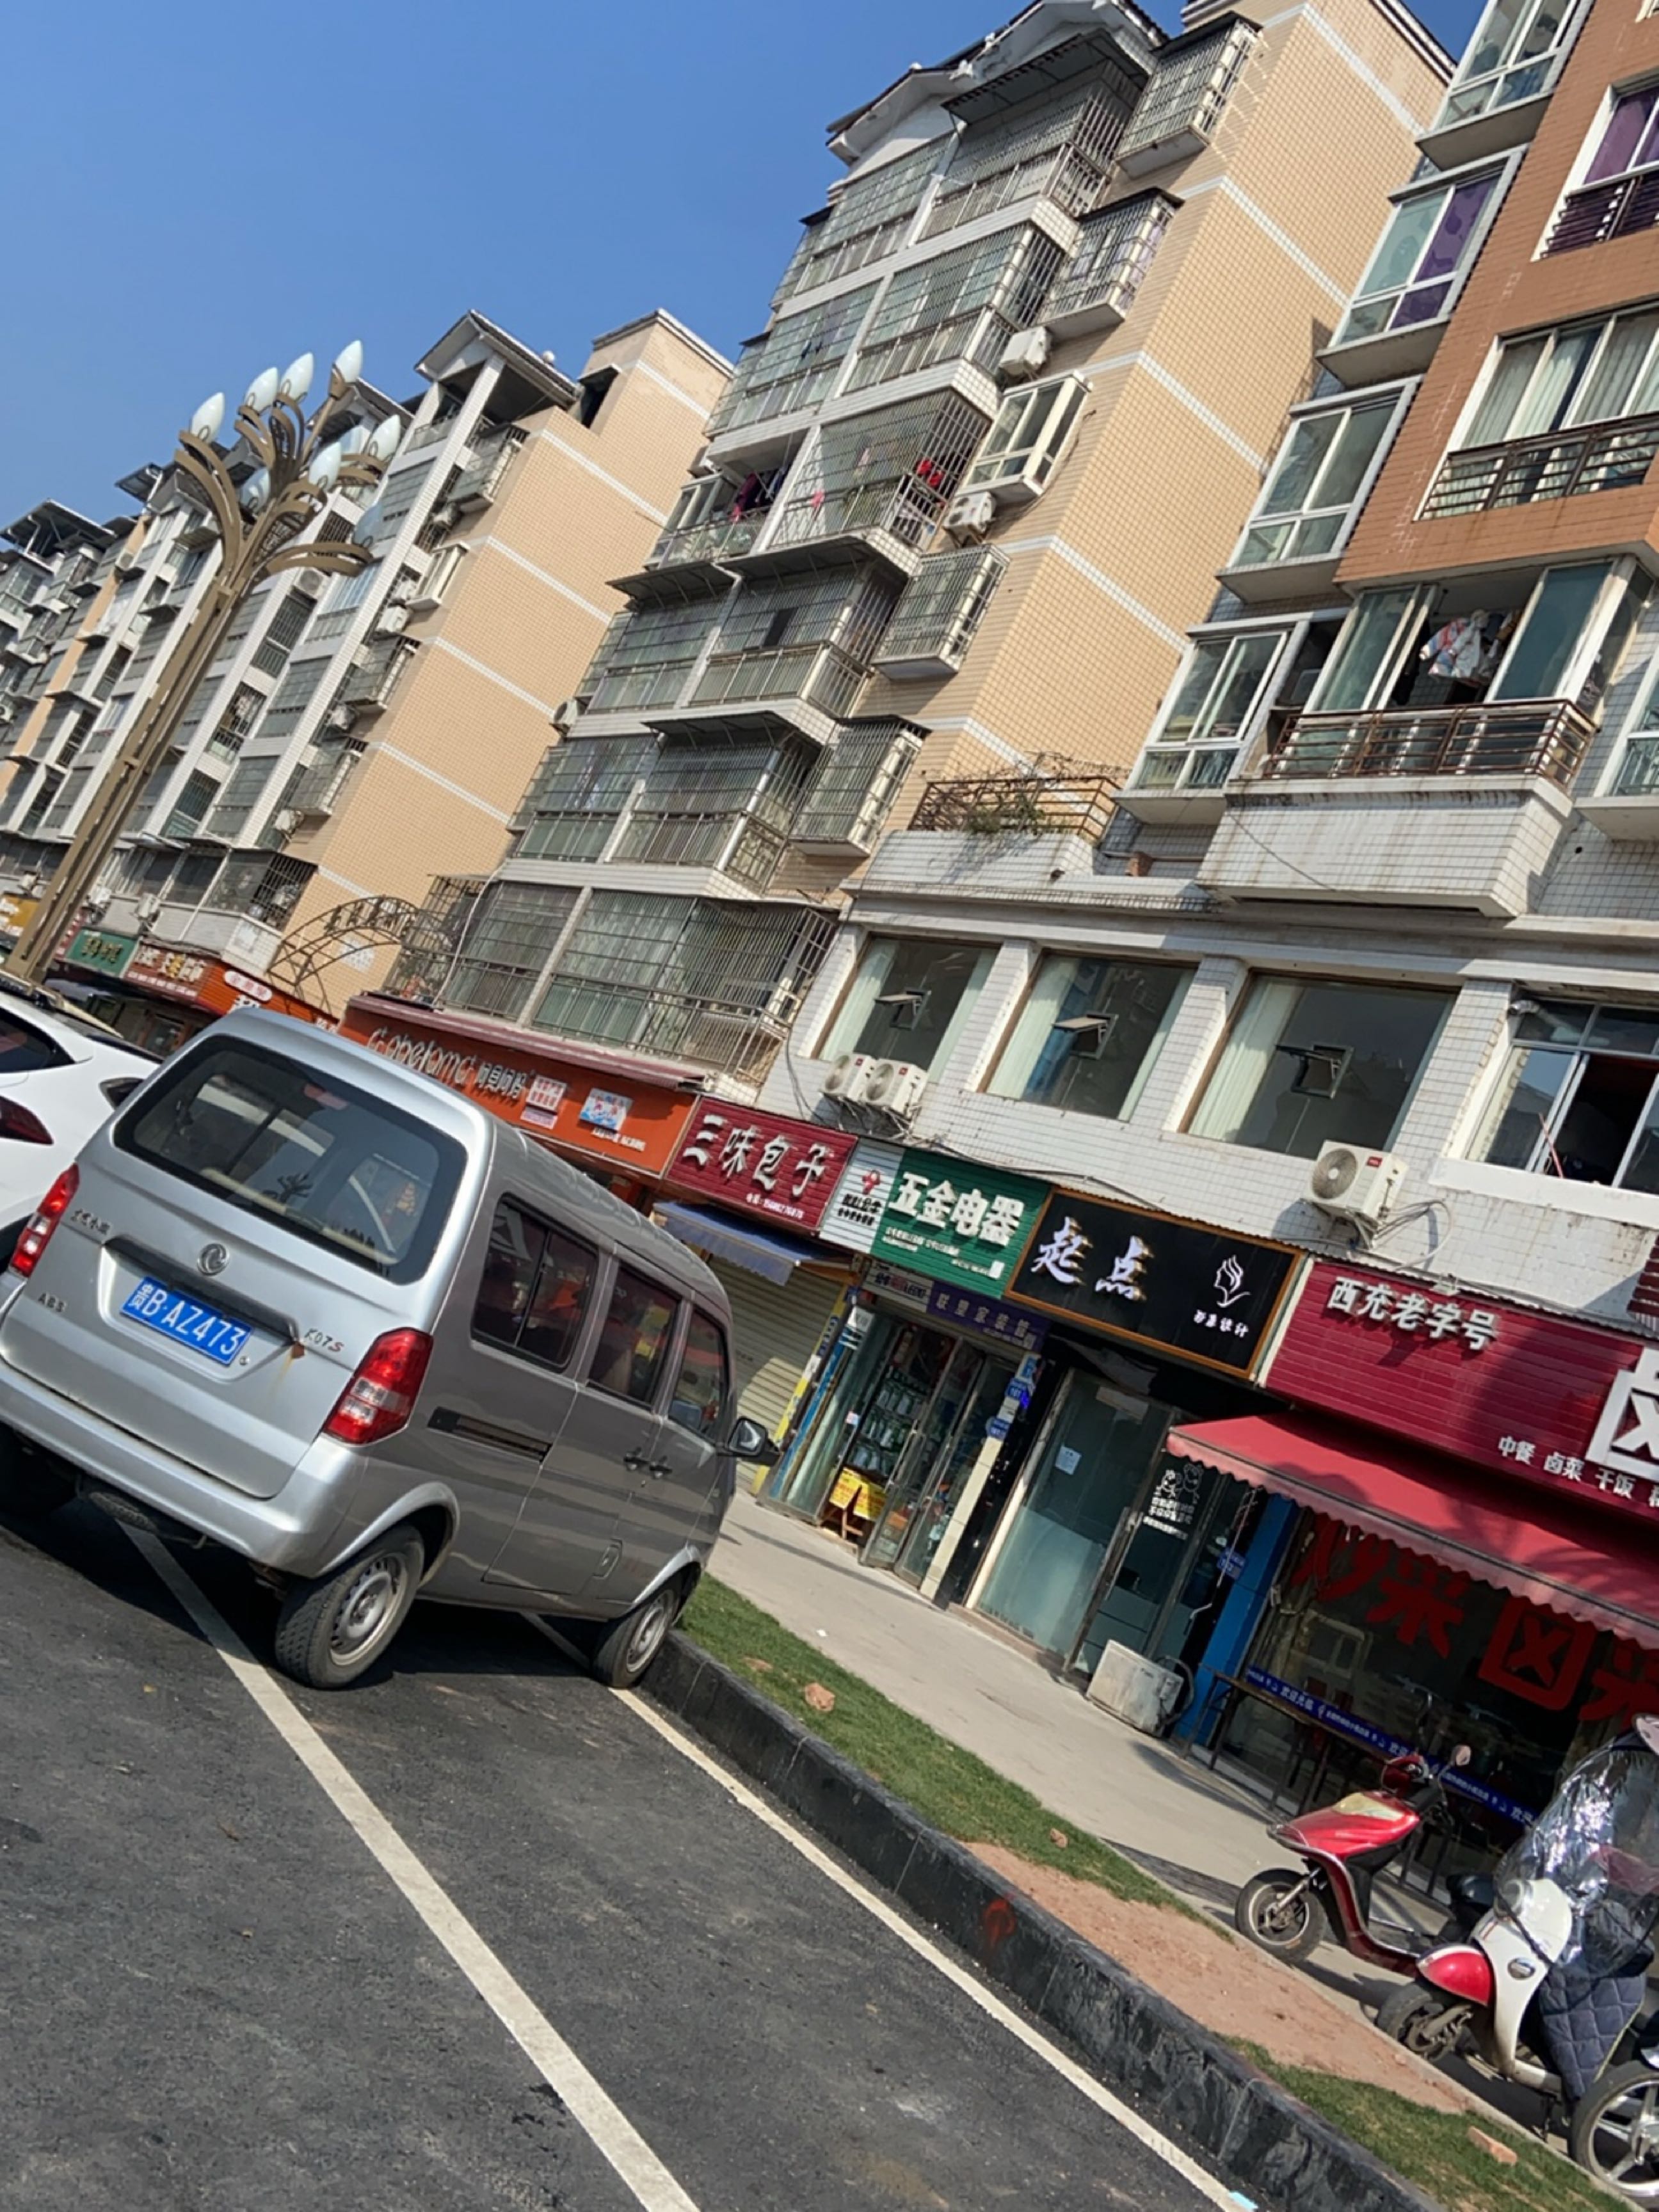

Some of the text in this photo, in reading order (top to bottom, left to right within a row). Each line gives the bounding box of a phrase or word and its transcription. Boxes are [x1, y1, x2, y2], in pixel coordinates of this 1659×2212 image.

[682, 1115, 827, 1197] 三味包子
[886, 1171, 1024, 1247] 五金电器
[1030, 1215, 1150, 1301] 起点
[38, 1292, 65, 1313] ABS
[1327, 1276, 1498, 1350] 西充老字号
[304, 1327, 345, 1354] K07S
[1498, 1435, 1535, 1465] 中餐
[1543, 1451, 1585, 1482] 卤菜
[1595, 1466, 1637, 1499] 干饭
